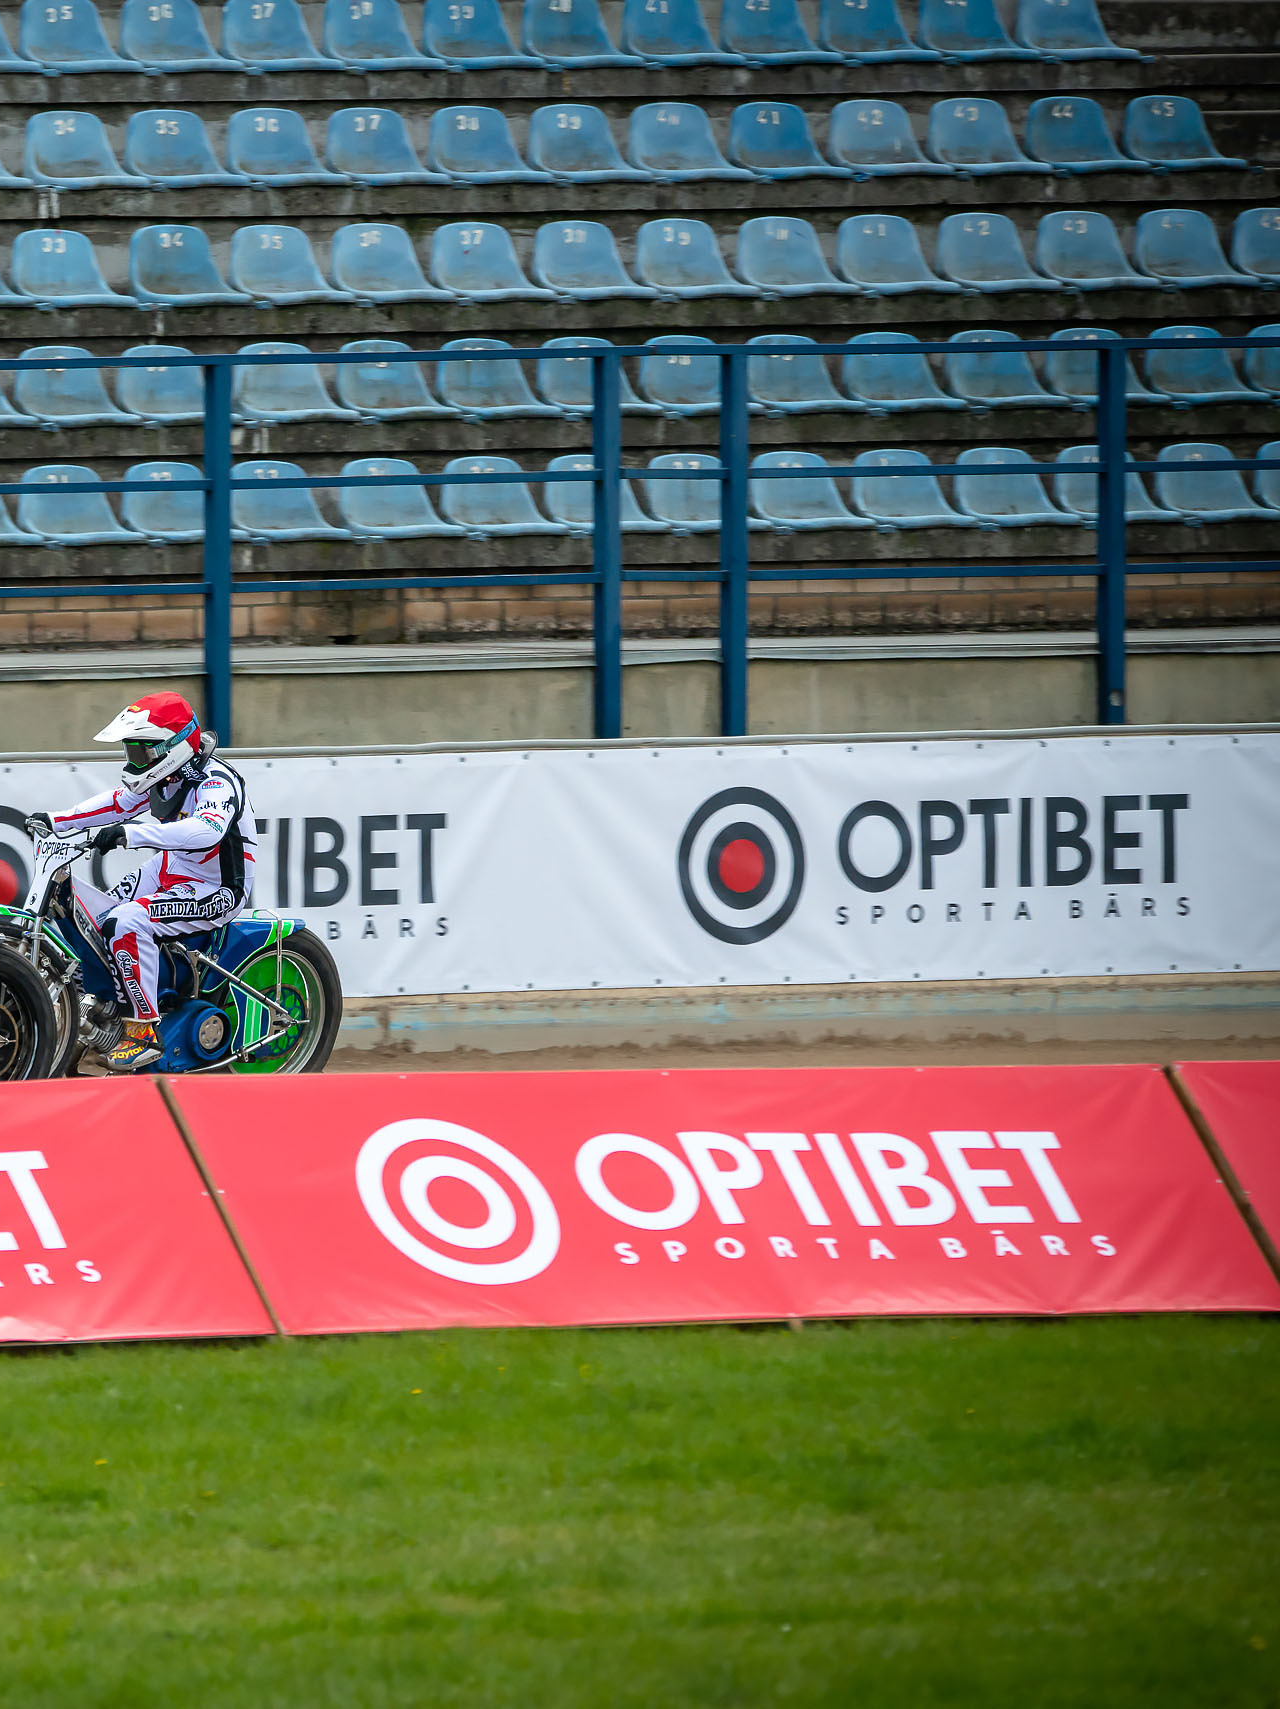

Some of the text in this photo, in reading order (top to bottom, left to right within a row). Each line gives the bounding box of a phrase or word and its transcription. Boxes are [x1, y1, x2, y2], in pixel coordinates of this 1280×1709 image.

[45, 5, 73, 23] 35
[148, 3, 174, 22] 36
[251, 2, 275, 20] 37
[349, 1, 373, 20] 38
[447, 4, 475, 20] 39
[755, 110, 780, 125] 41
[857, 108, 883, 126] 42
[953, 105, 979, 121] 43
[1051, 104, 1073, 119] 44
[1151, 101, 1175, 117] 45
[53, 118, 76, 136] 34
[155, 119, 180, 135] 35
[254, 116, 279, 133] 36
[354, 114, 381, 132] 37
[556, 112, 582, 130] 39
[663, 226, 691, 246] 39
[862, 223, 886, 237] 41
[963, 220, 990, 236] 42
[41, 237, 67, 254] 33
[159, 232, 183, 249] 34
[259, 233, 283, 250] 35
[358, 230, 384, 247] 36
[459, 229, 484, 245] 37
[41, 843, 70, 856] OPTIBET
[837, 793, 1192, 893] OPTIBET
[255, 812, 448, 909] IBET
[836, 892, 1191, 927] SPORTA BĀRS
[328, 914, 448, 942] BĀRS
[574, 1130, 1082, 1231] OPTIBET
[613, 1229, 1116, 1265] SPORTA BĀRS
